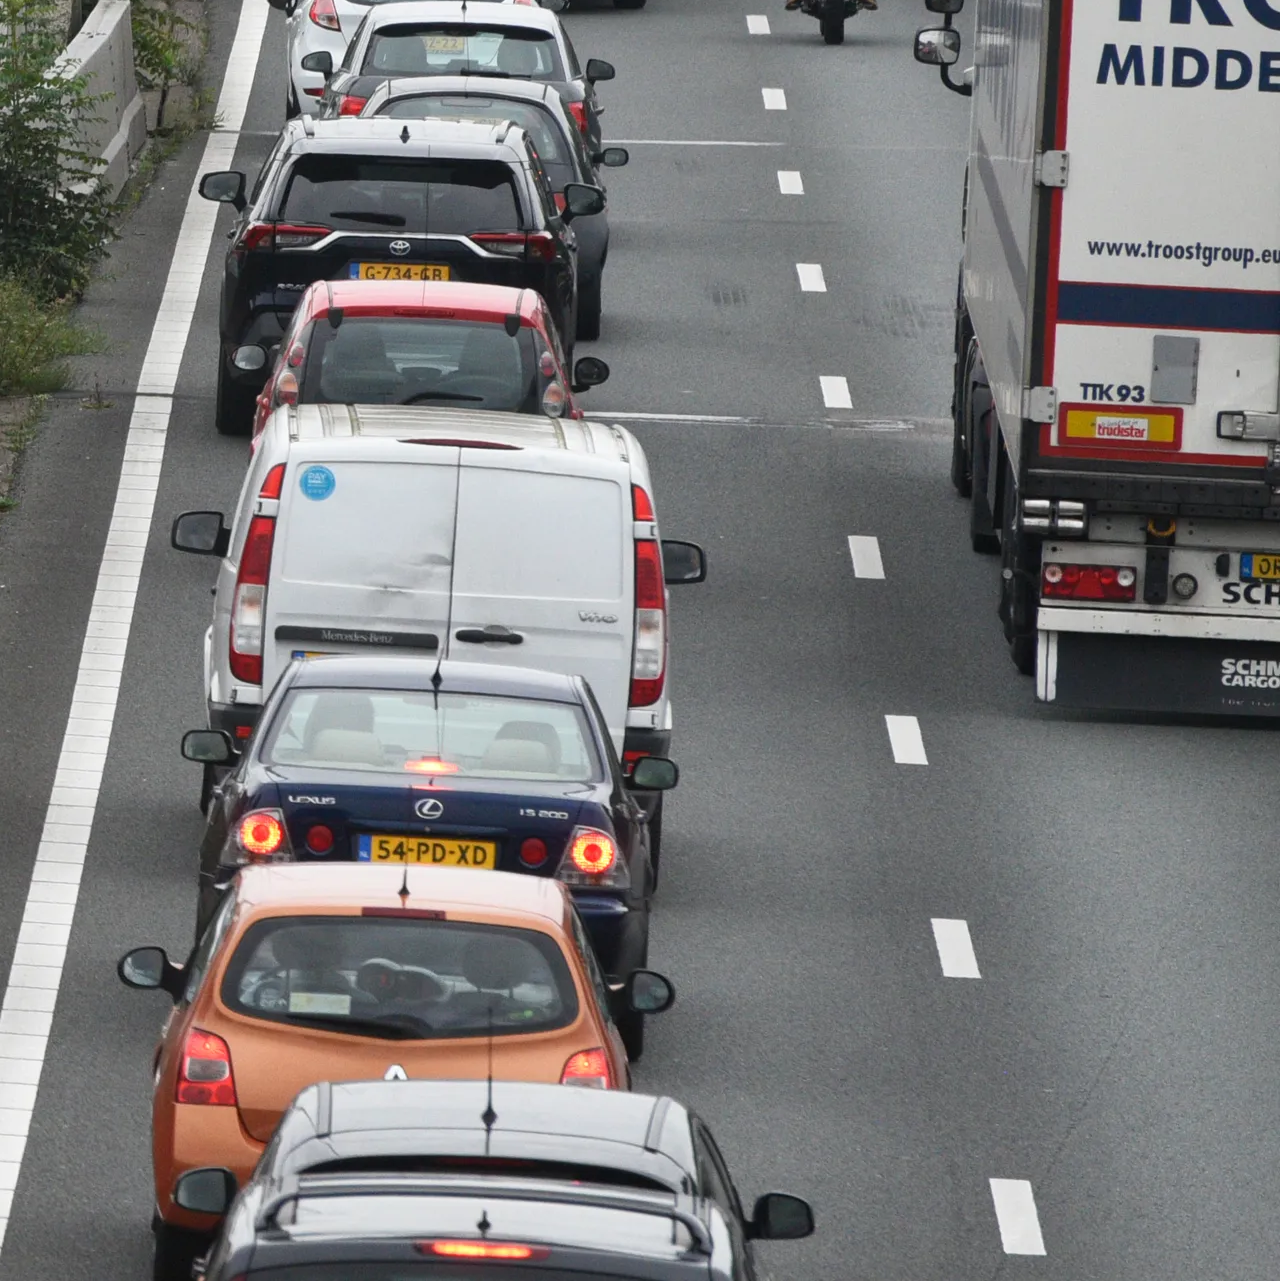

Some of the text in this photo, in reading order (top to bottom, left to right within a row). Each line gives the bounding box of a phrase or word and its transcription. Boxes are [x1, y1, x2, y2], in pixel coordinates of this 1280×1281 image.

[1096, 43, 1280, 93] MIDDE
[1080, 382, 1146, 403] TTK 93
[288, 795, 337, 805] LEXUS
[377, 839, 488, 866] 54-PD-XD
